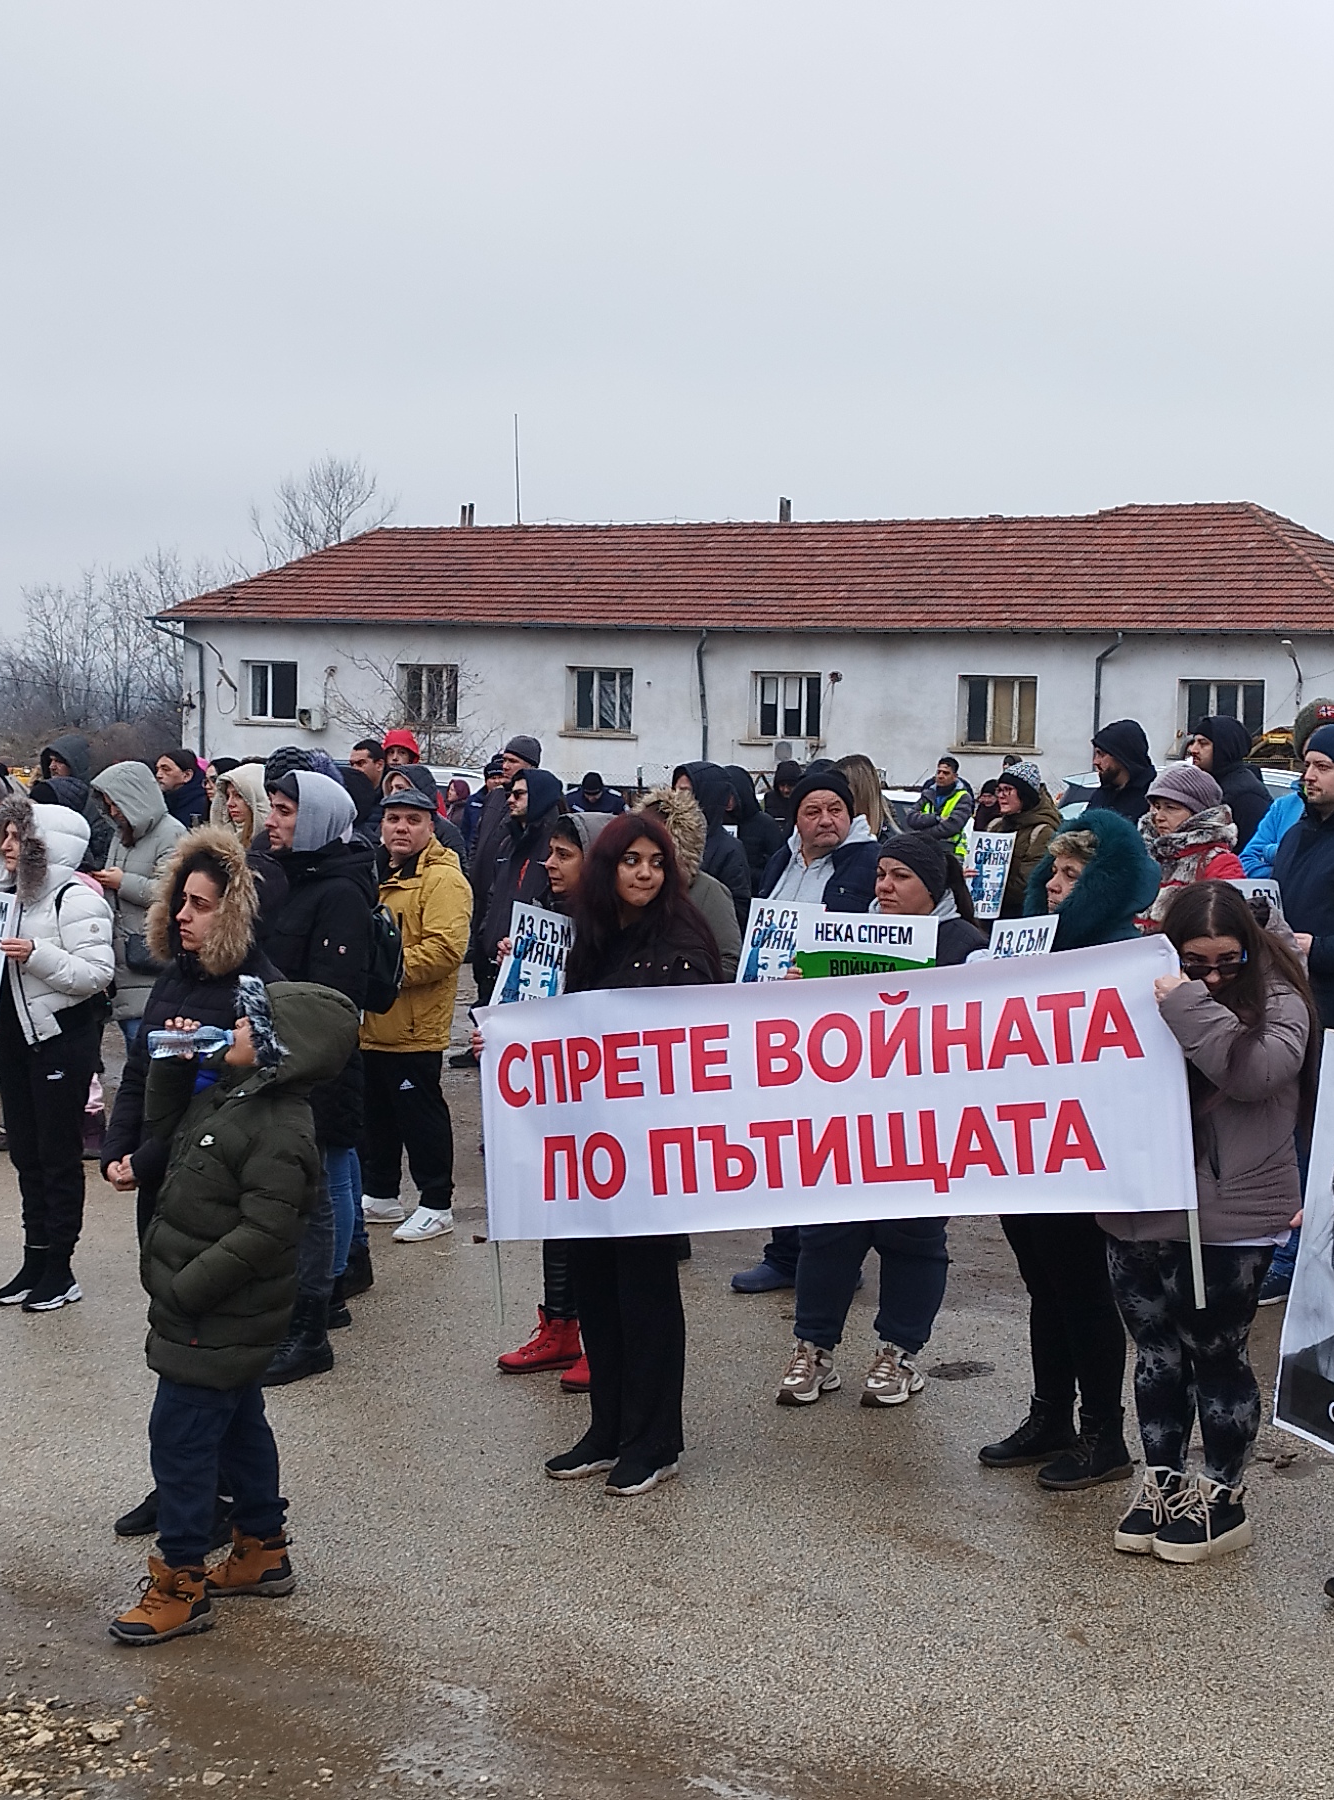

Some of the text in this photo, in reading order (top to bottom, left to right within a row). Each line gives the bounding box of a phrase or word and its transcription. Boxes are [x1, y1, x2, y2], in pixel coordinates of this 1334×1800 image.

[515, 912, 572, 949] АЗ СЪМ
[754, 907, 775, 928] АЗ
[814, 922, 914, 946] НЕКА СПРЕМ
[992, 926, 1049, 956] АЗ СЪМ
[829, 956, 897, 978] ВОЙНАТА
[497, 987, 1146, 1109] СПРЕТЕ ВОЙНАТА
[543, 1098, 1107, 1202] ПО ПЪТИЩАТА
